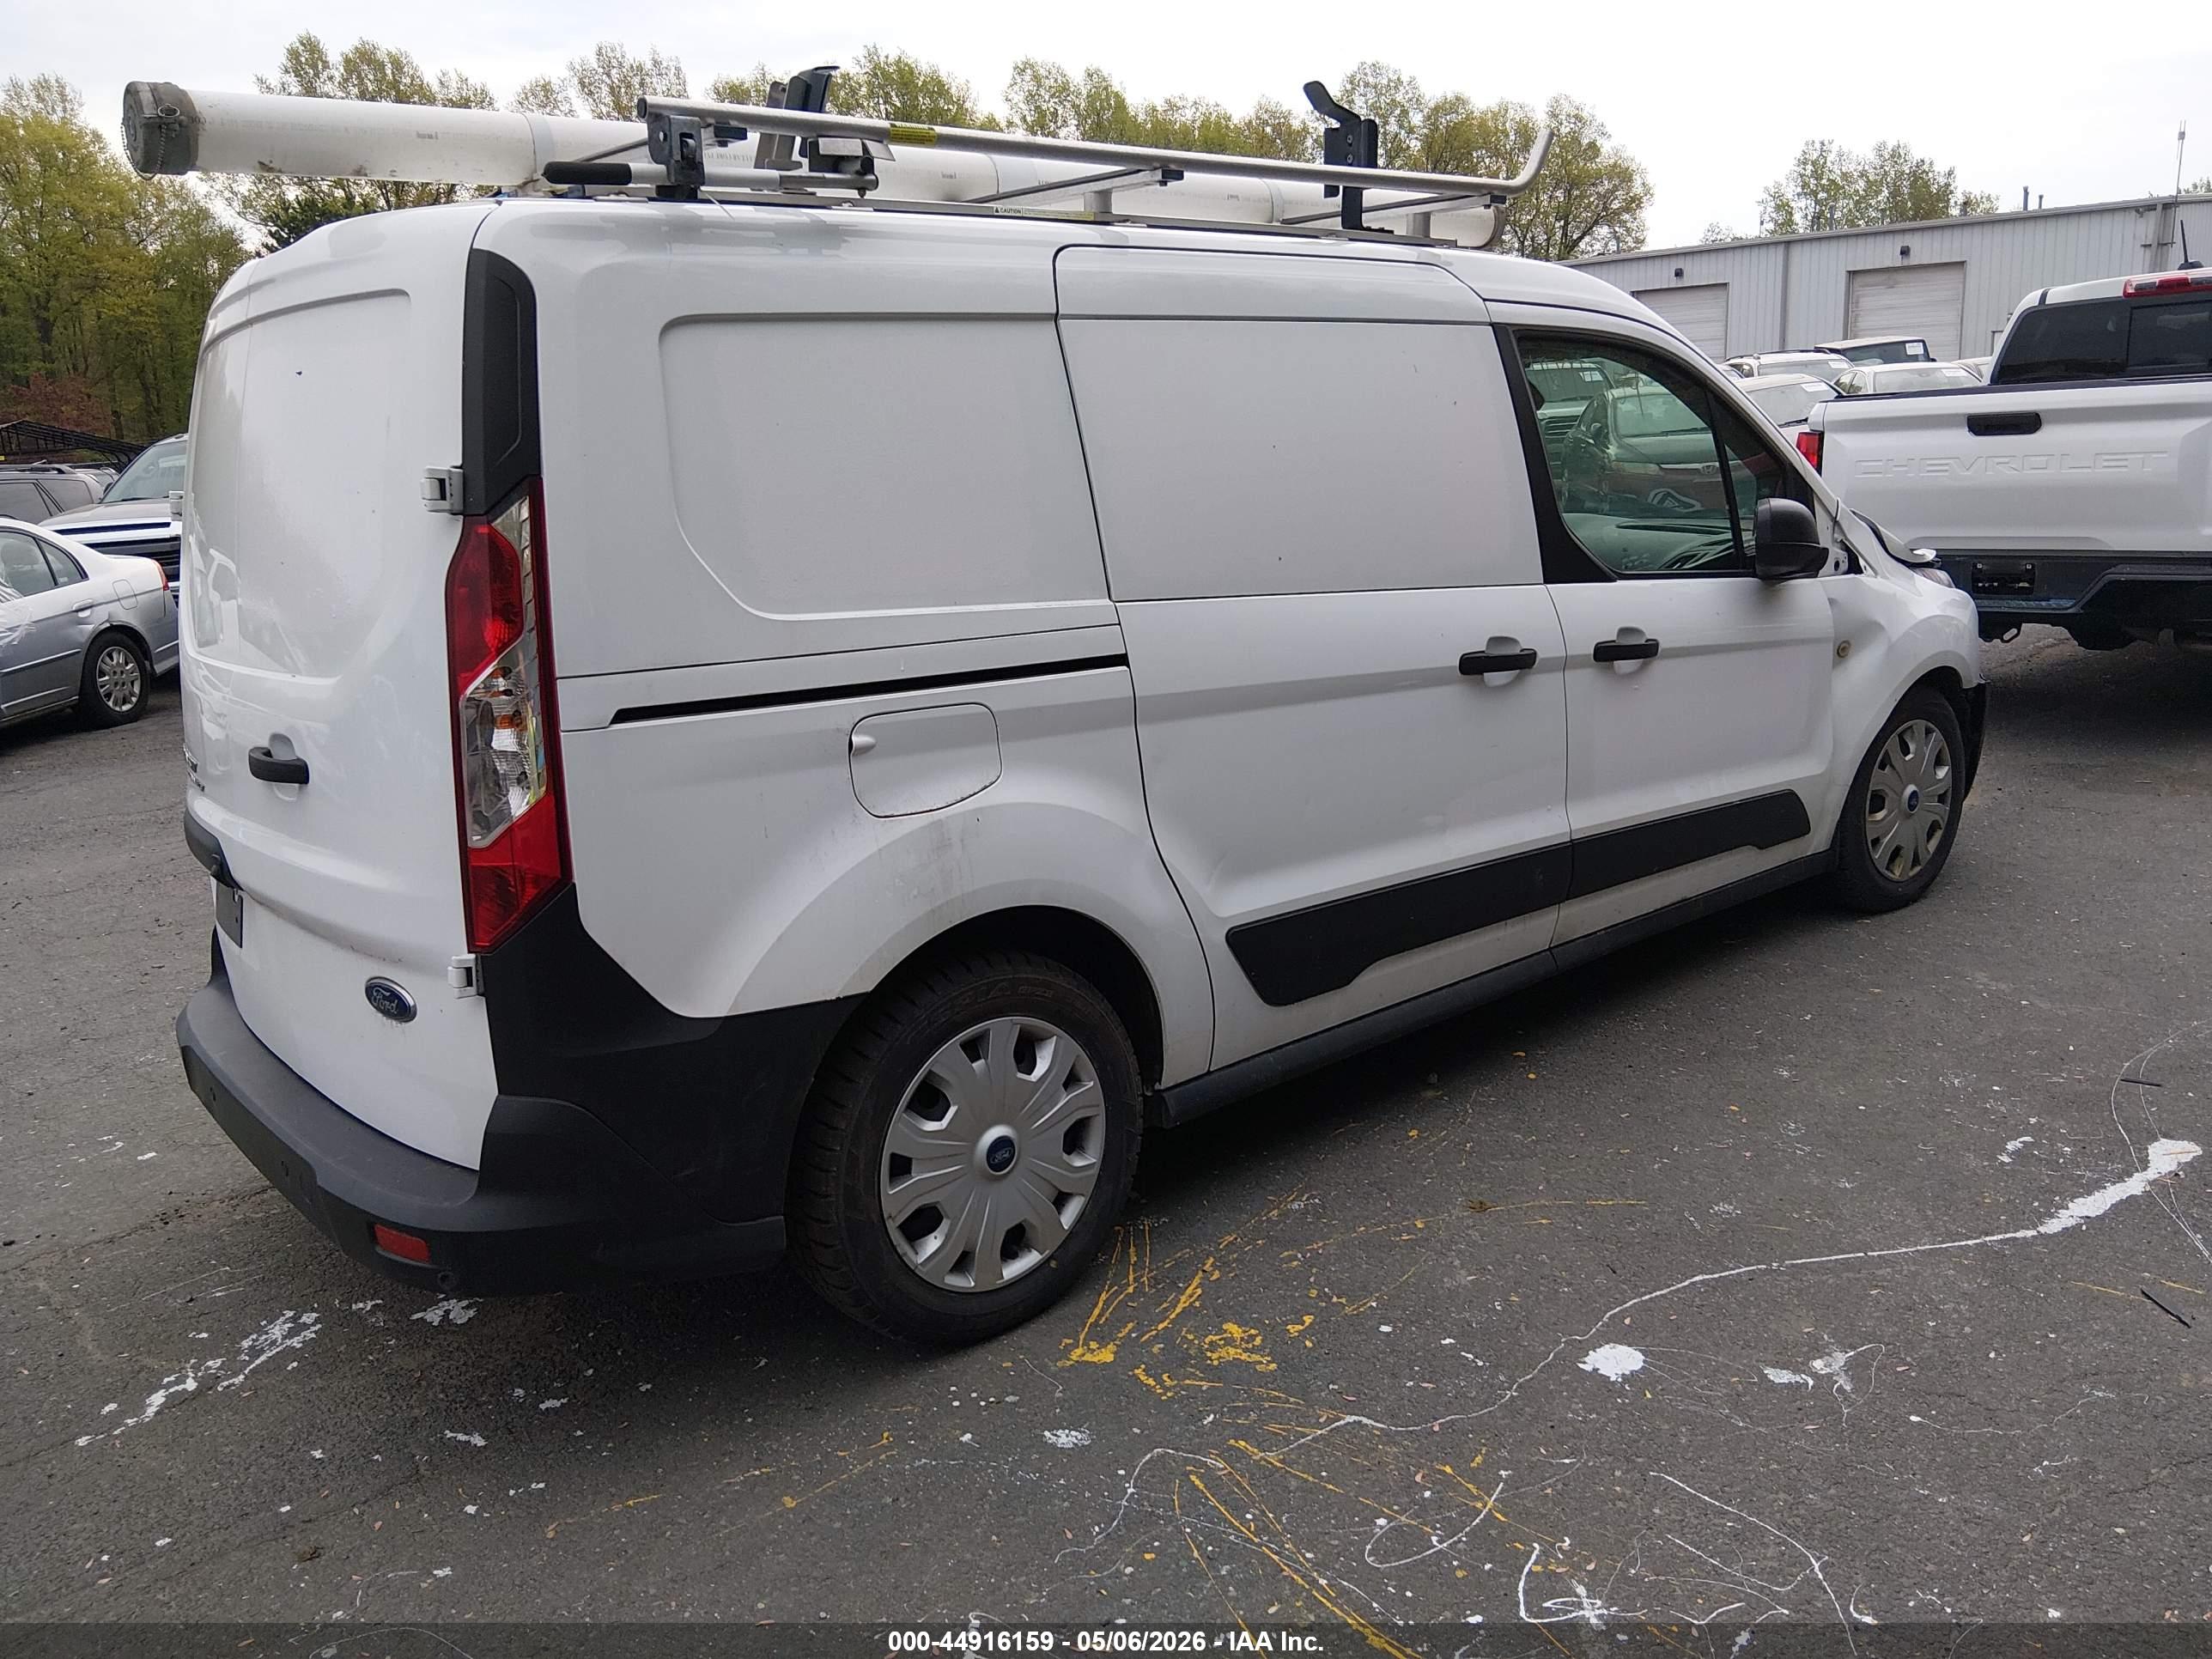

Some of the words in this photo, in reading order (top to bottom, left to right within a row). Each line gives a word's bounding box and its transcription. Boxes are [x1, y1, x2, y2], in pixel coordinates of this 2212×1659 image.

[1000, 206, 1022, 215] CAUTION
[1854, 450, 2169, 478] CHEVROLET
[371, 987, 398, 1014] Ford
